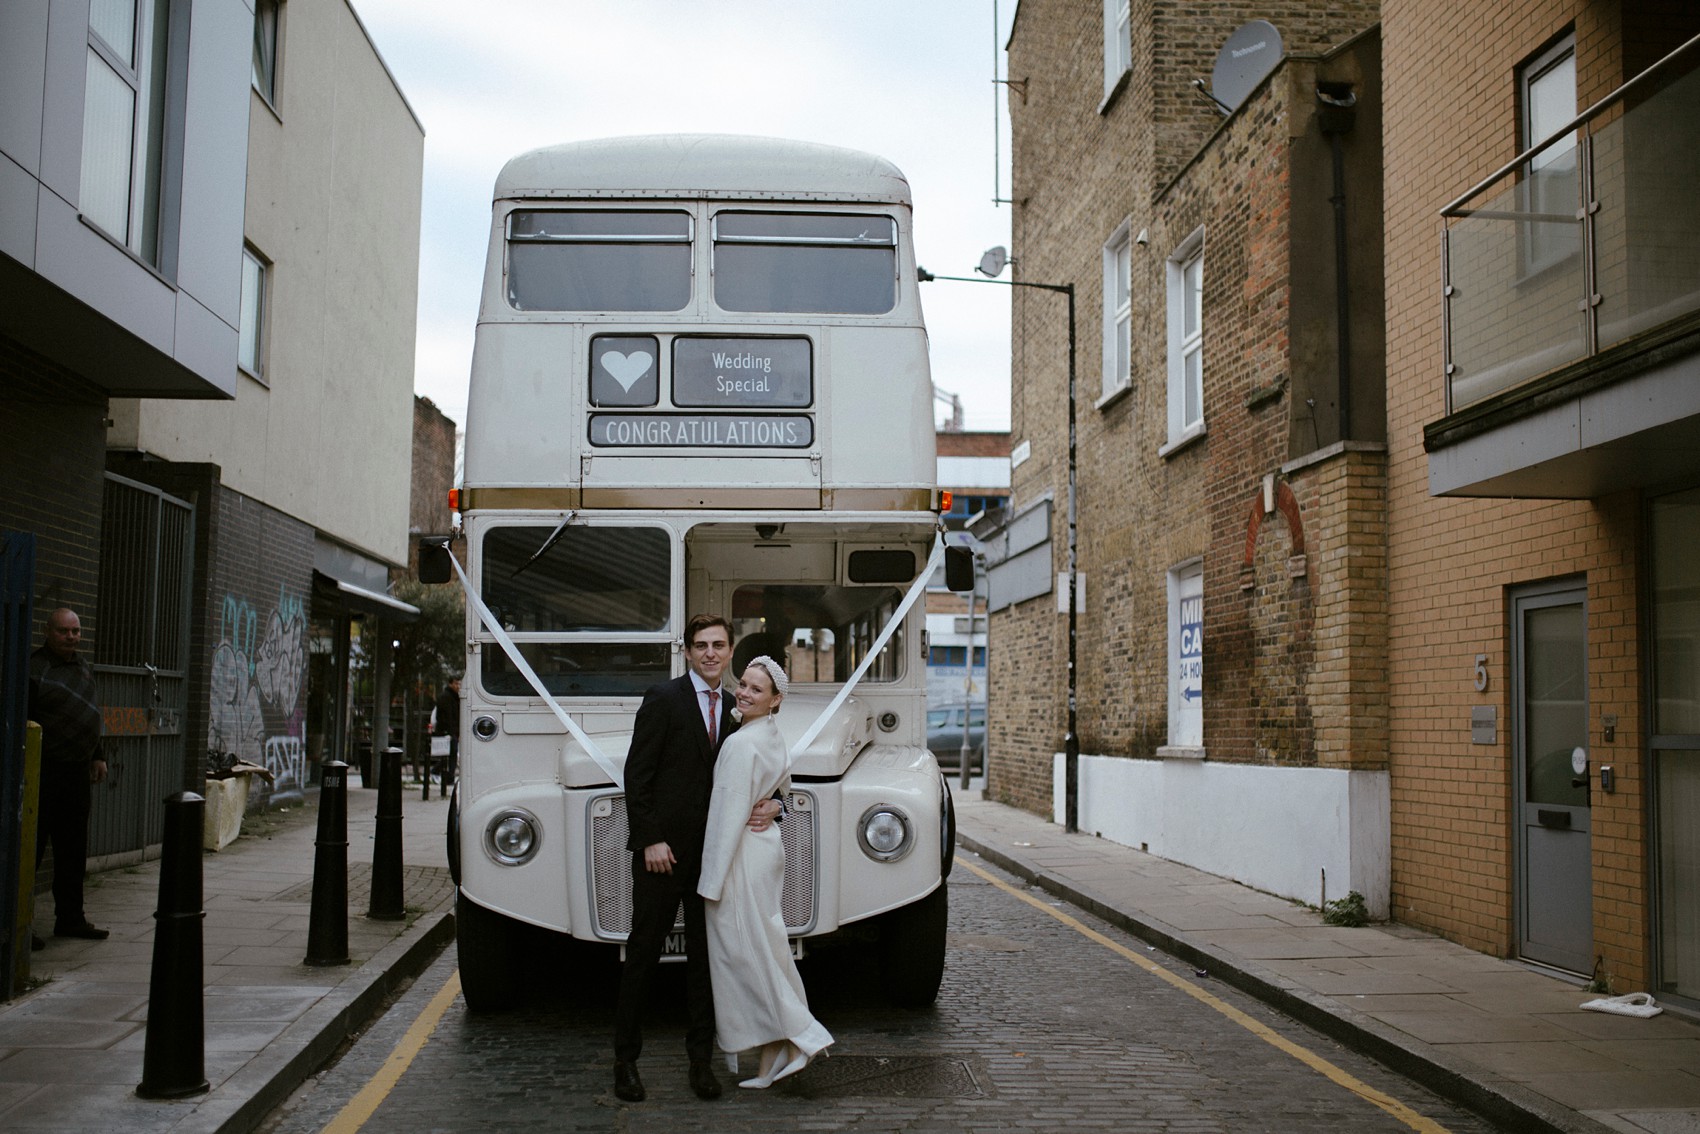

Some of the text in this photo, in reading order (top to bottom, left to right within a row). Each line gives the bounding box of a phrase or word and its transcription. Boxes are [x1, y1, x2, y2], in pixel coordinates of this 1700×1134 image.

[712, 352, 772, 373] Wedding
[716, 375, 770, 396] Special
[605, 421, 798, 445] CONGRATULATIONS
[1180, 664, 1188, 680] 24
[1474, 654, 1487, 692] 5
